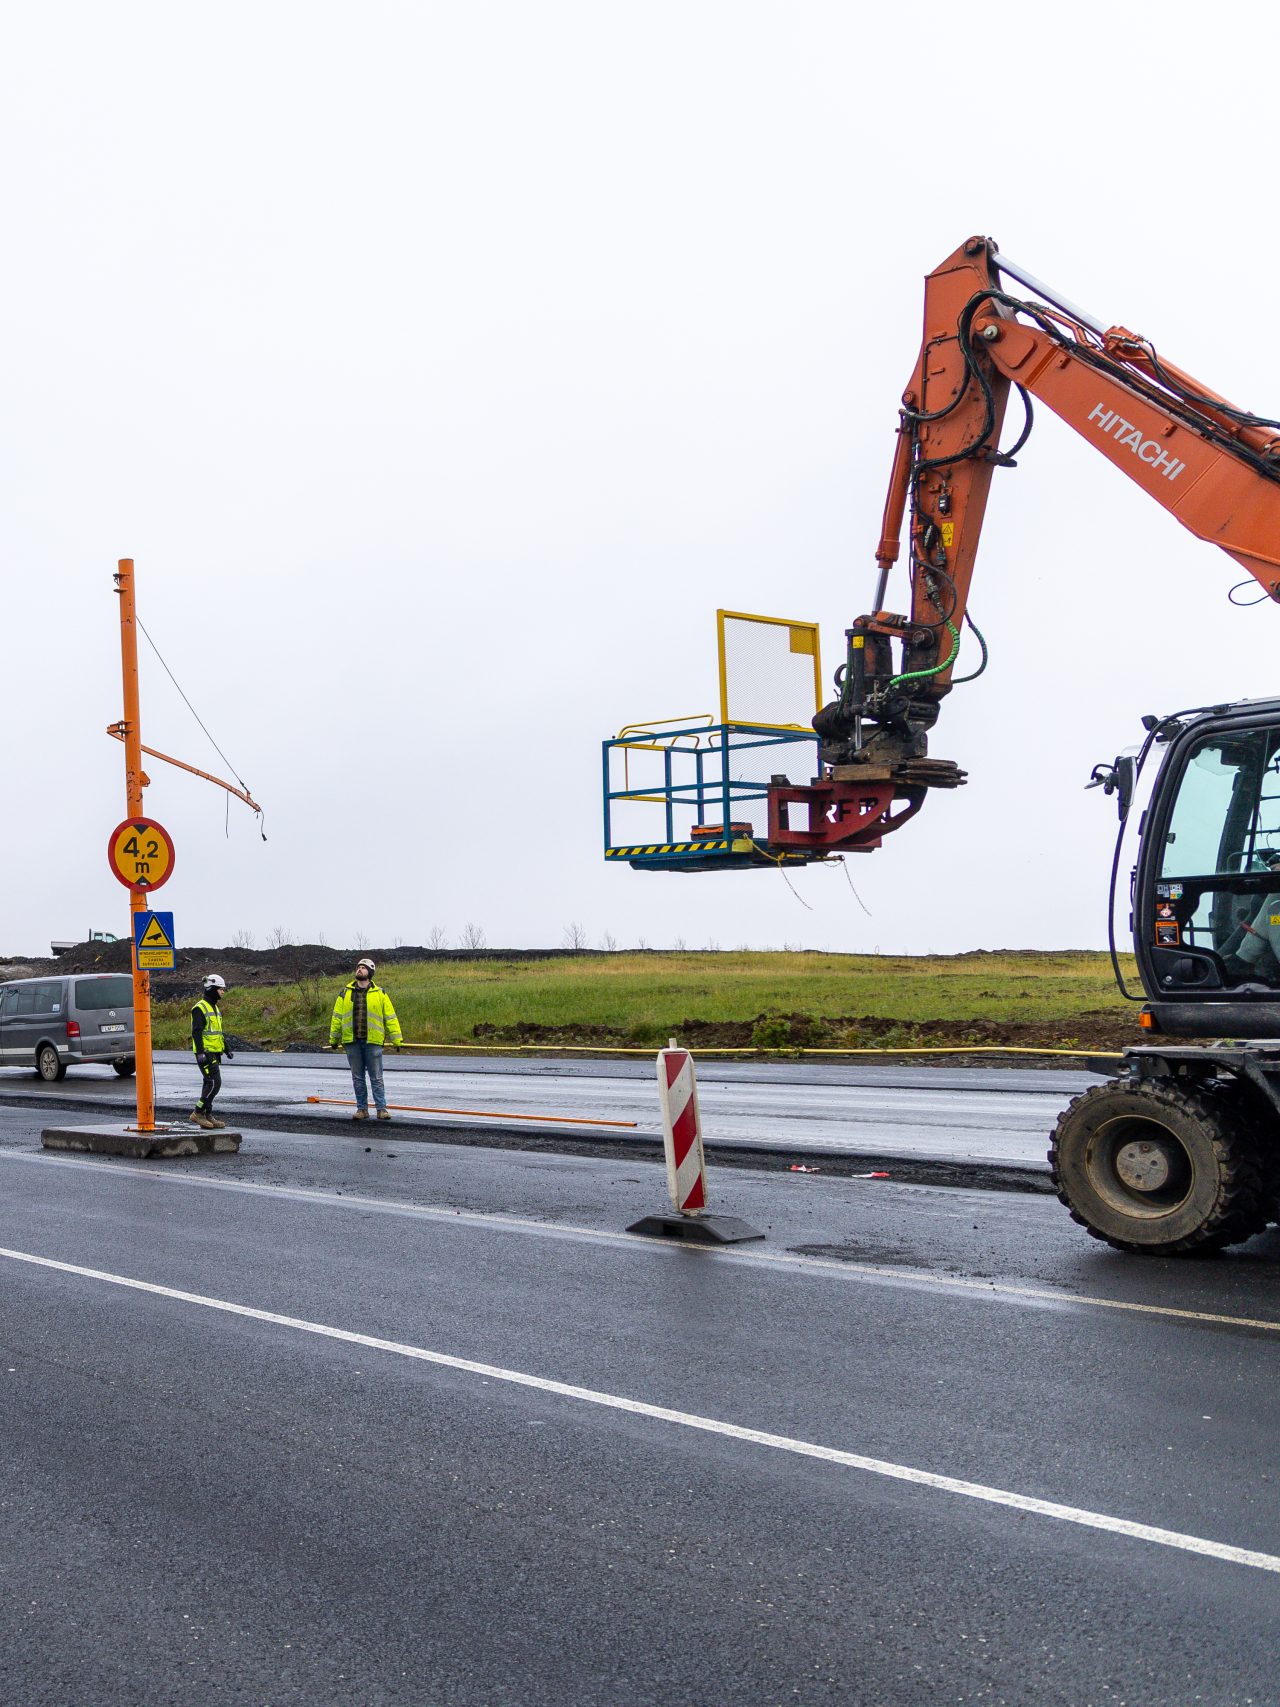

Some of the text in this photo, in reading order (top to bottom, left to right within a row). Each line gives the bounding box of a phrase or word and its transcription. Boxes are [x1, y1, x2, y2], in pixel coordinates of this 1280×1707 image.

[1087, 402, 1186, 481] HITACHI
[122, 836, 159, 860] 4,2
[135, 861, 150, 874] m
